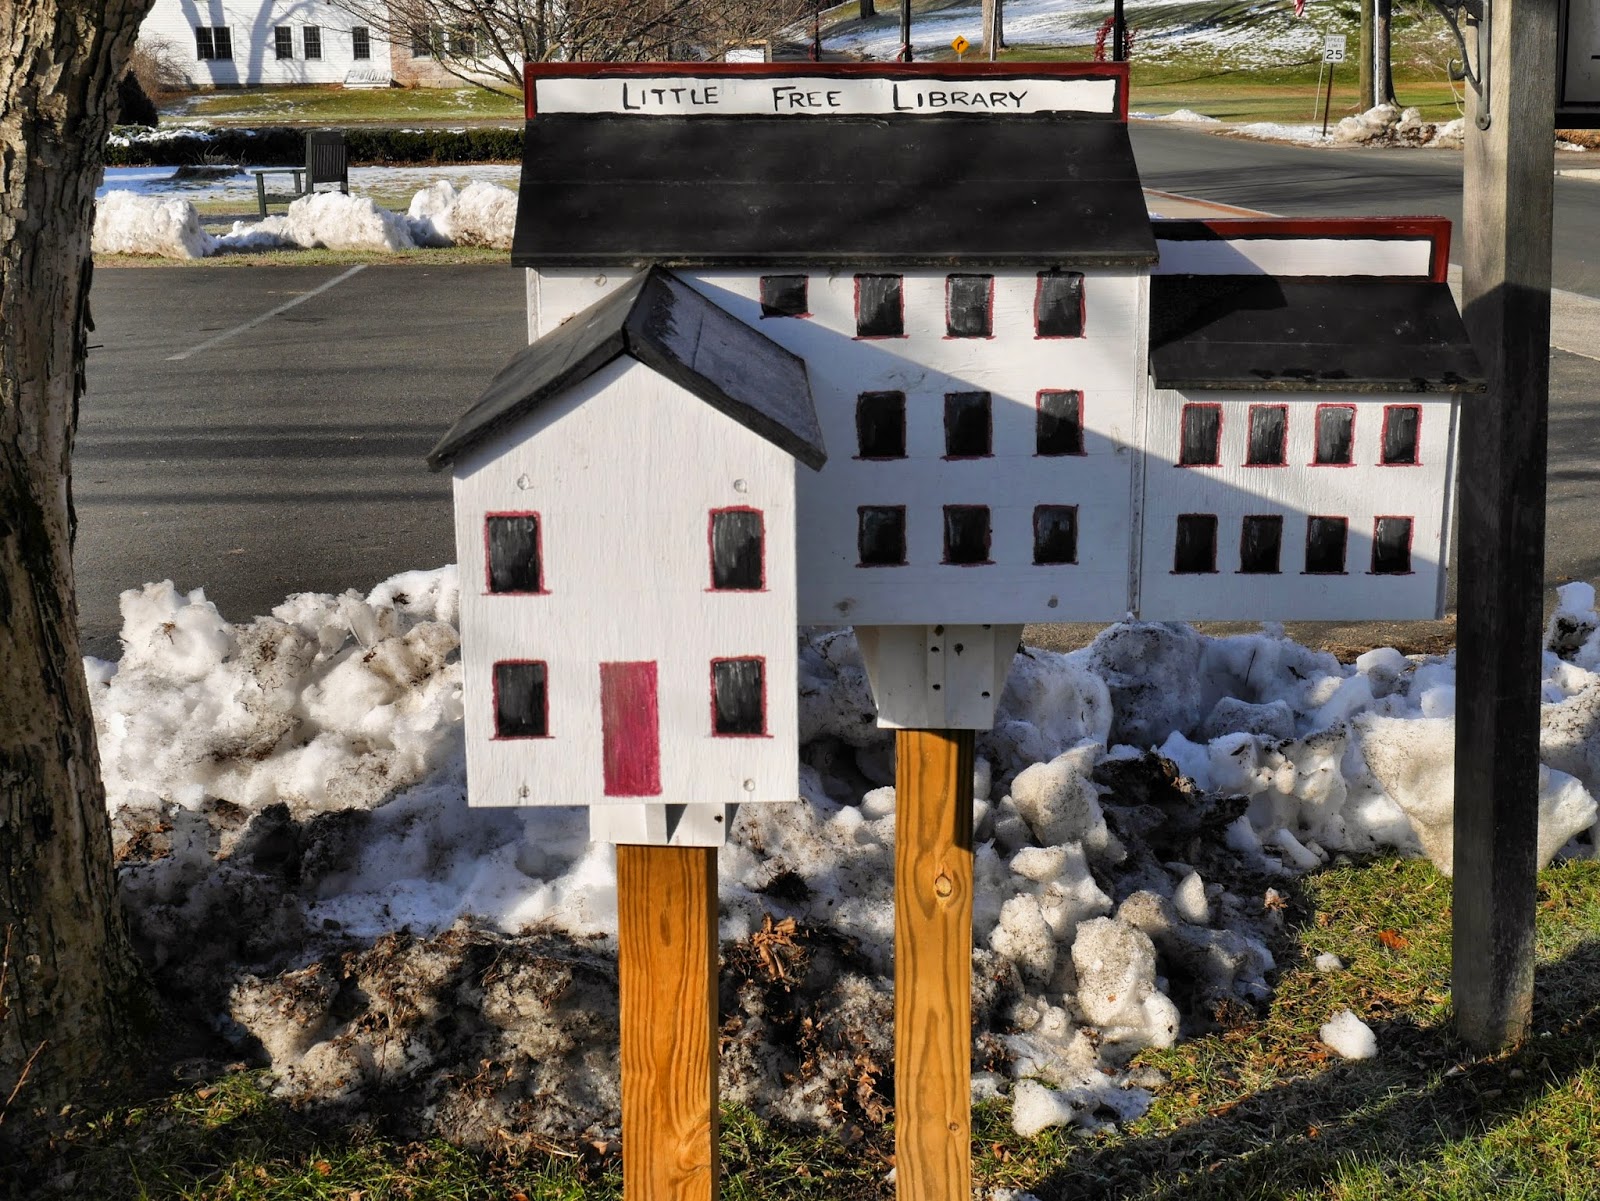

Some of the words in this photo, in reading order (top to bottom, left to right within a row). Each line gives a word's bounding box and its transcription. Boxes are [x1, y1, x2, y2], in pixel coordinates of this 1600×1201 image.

[1326, 49, 1343, 60] 25
[623, 82, 719, 110] LITTLE
[772, 86, 842, 111] FREE
[892, 83, 1028, 111] LIBRARY
